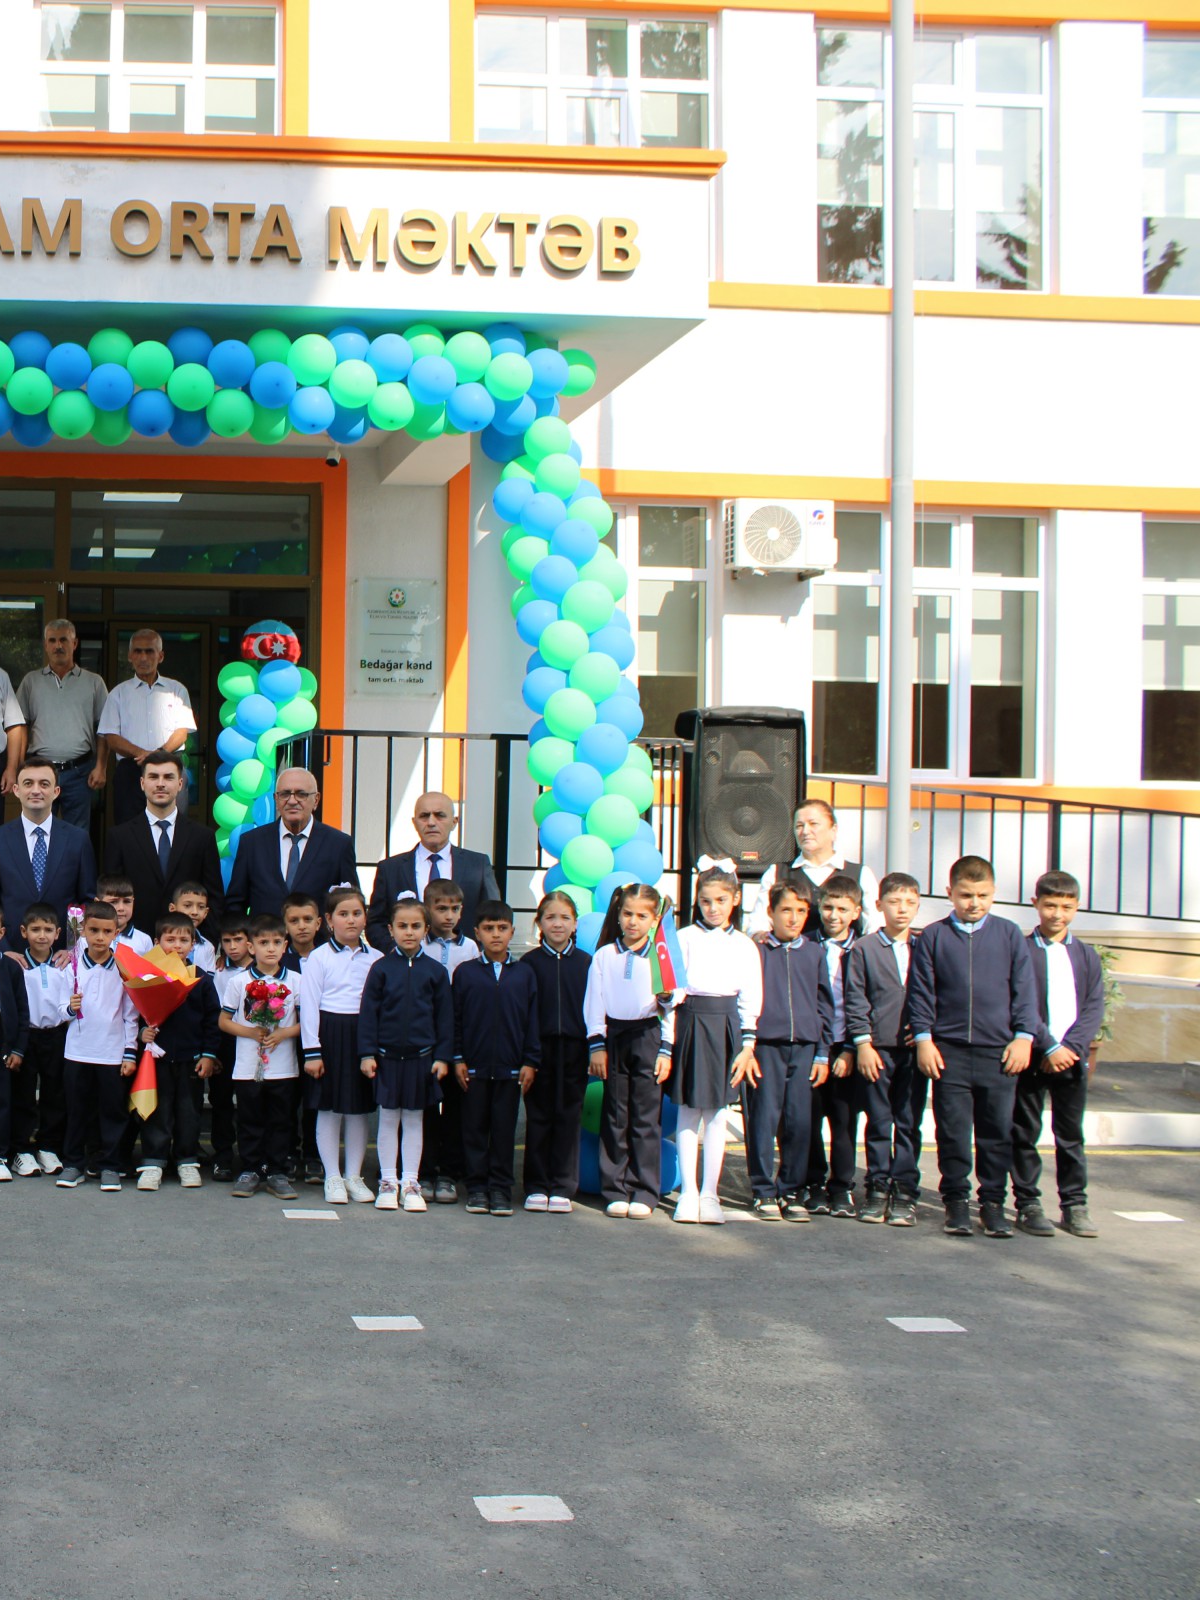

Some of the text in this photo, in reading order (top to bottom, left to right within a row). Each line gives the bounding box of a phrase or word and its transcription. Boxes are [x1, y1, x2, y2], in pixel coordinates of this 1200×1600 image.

[109, 199, 303, 262] ORTA
[326, 205, 642, 274] MƏKTƏB
[360, 659, 433, 672] Bedağar kənd
